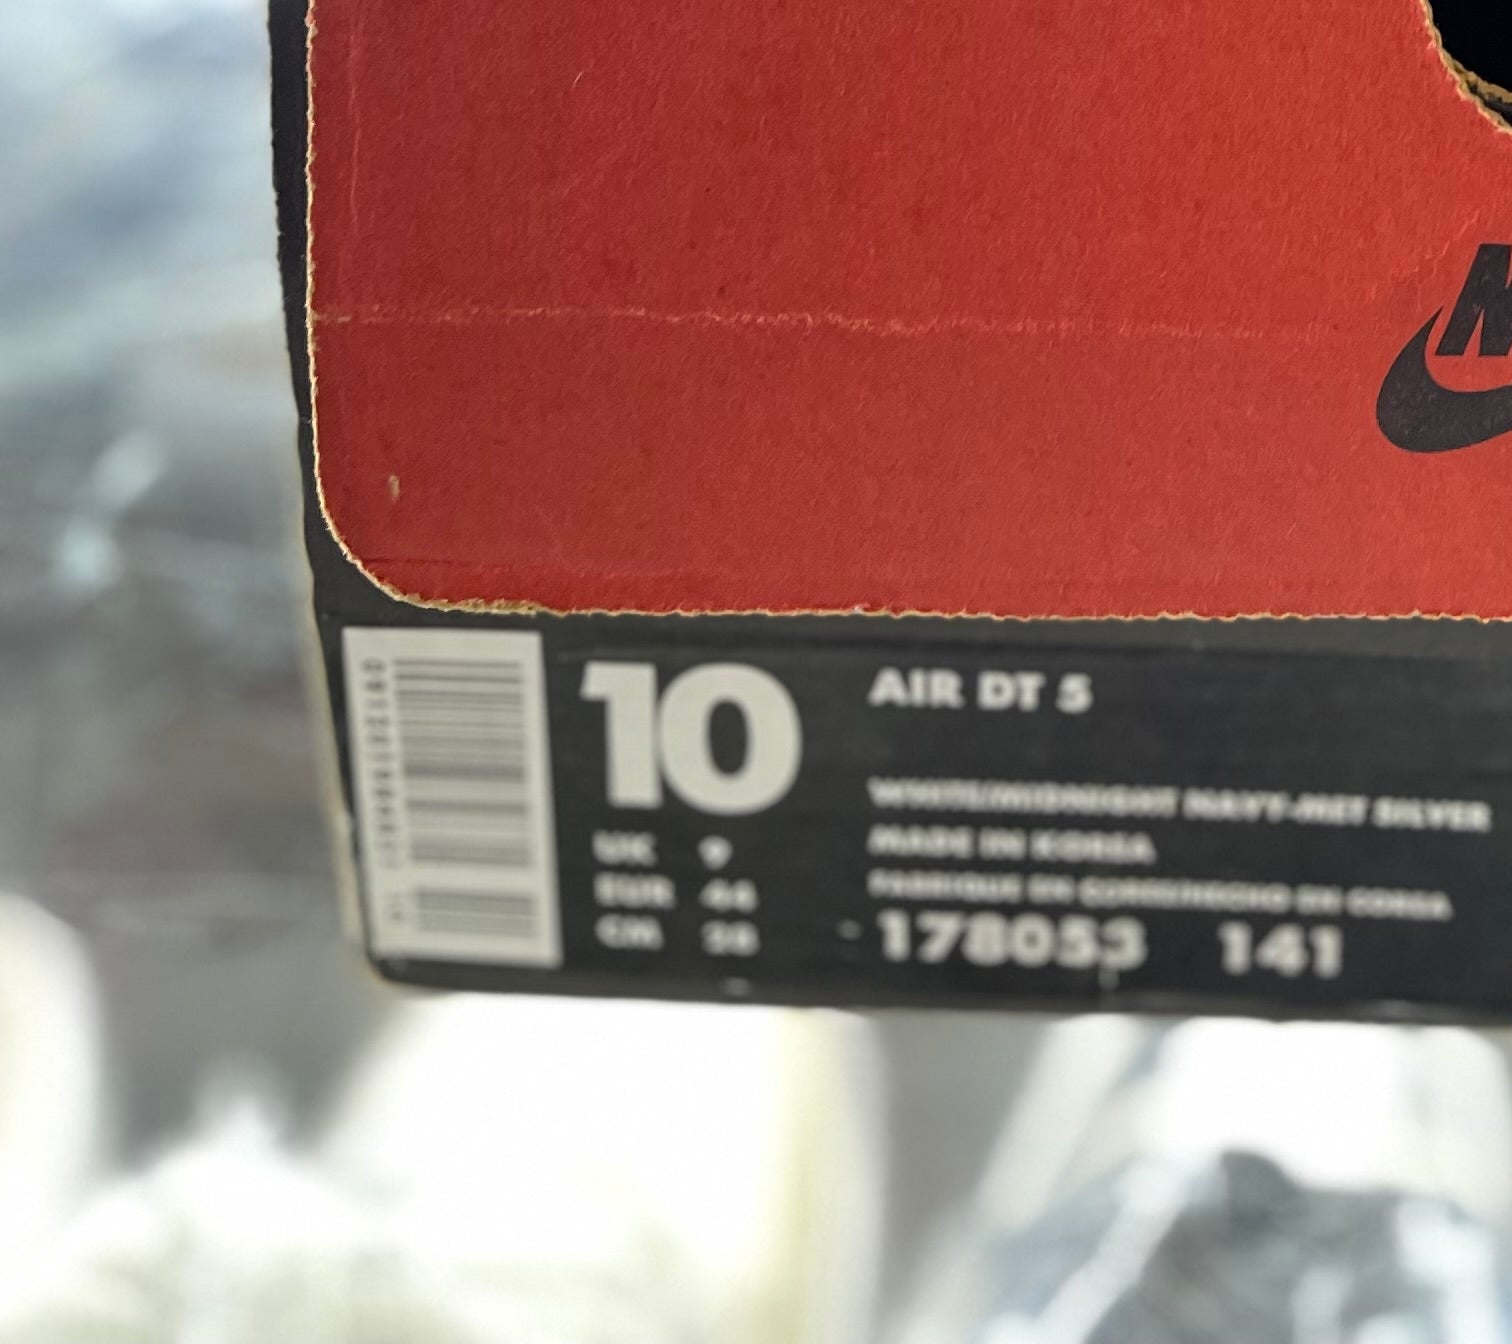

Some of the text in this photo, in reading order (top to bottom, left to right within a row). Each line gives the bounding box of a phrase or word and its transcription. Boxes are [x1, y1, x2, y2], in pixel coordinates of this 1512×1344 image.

[869, 667, 1093, 714] AIR DT 5
[580, 660, 802, 816] 10
[876, 909, 1344, 978] 178053 141
